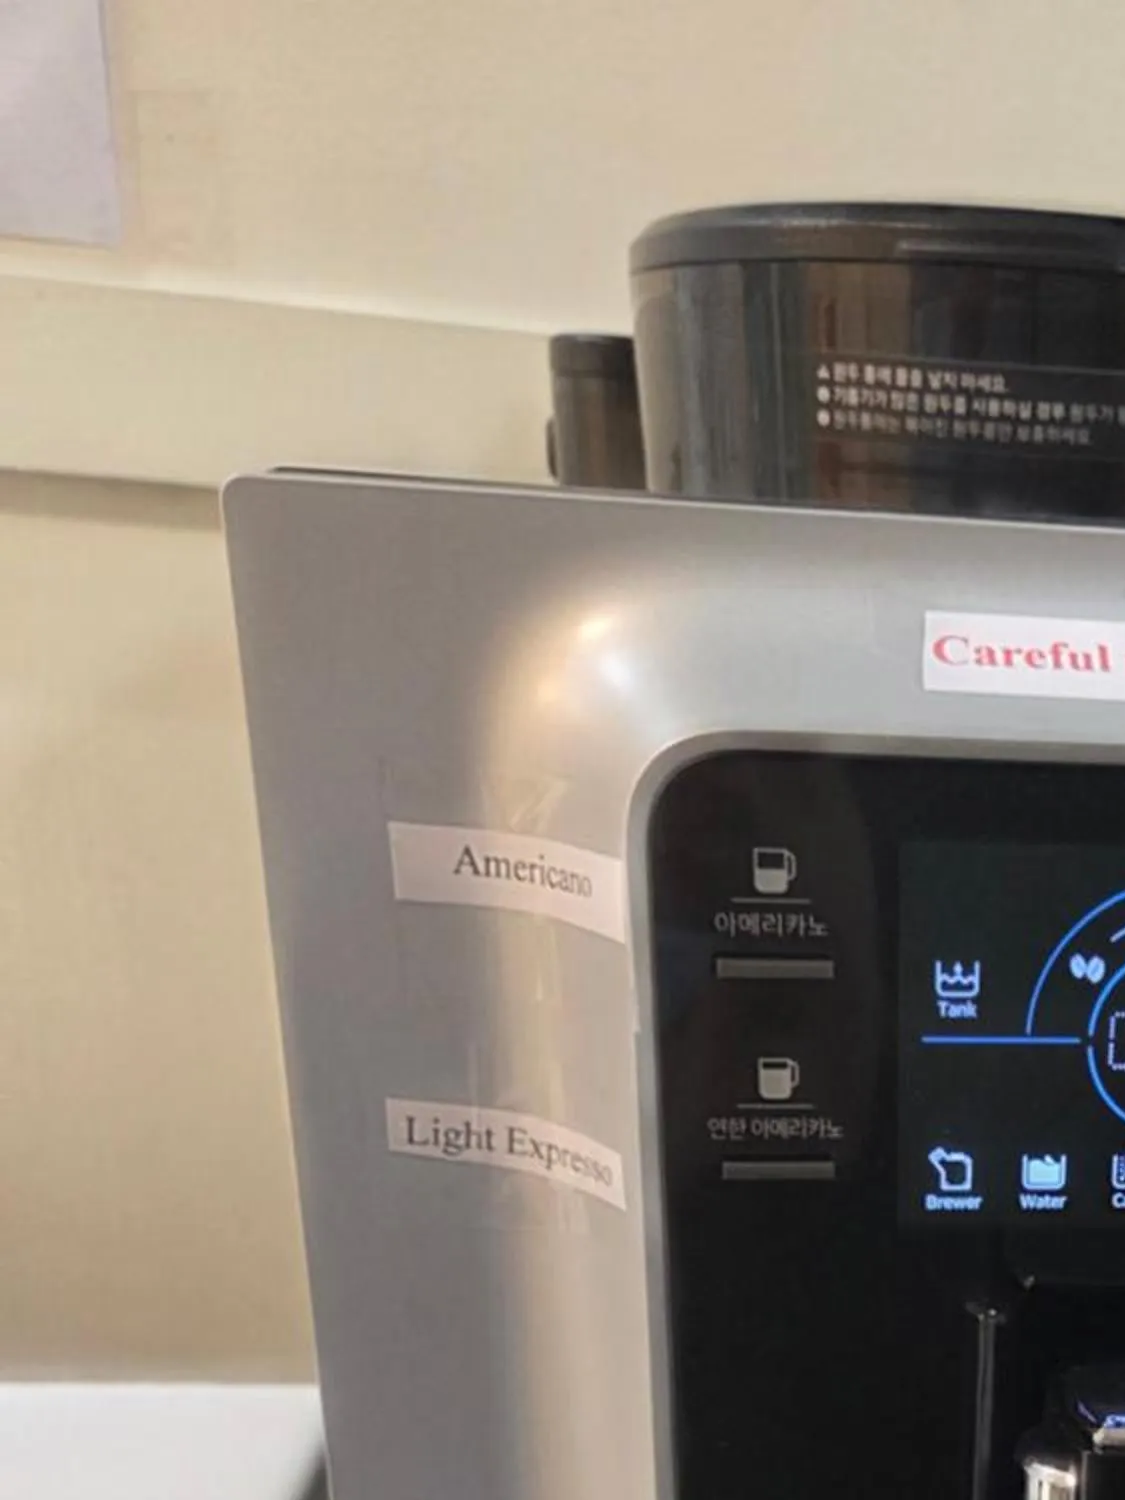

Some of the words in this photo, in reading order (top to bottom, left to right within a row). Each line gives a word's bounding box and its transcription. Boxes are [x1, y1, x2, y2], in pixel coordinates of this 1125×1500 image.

[932, 635, 1111, 673] Careful
[453, 845, 593, 899] Americano
[714, 912, 829, 937] 아메리카노
[937, 1001, 979, 1019] Tank
[707, 1117, 747, 1140] 연한
[751, 1117, 844, 1140] 아메리카노
[405, 1115, 494, 1156] Light
[506, 1126, 614, 1188] Expresso
[925, 1194, 982, 1211] Brewer
[1019, 1193, 1067, 1210] Water
